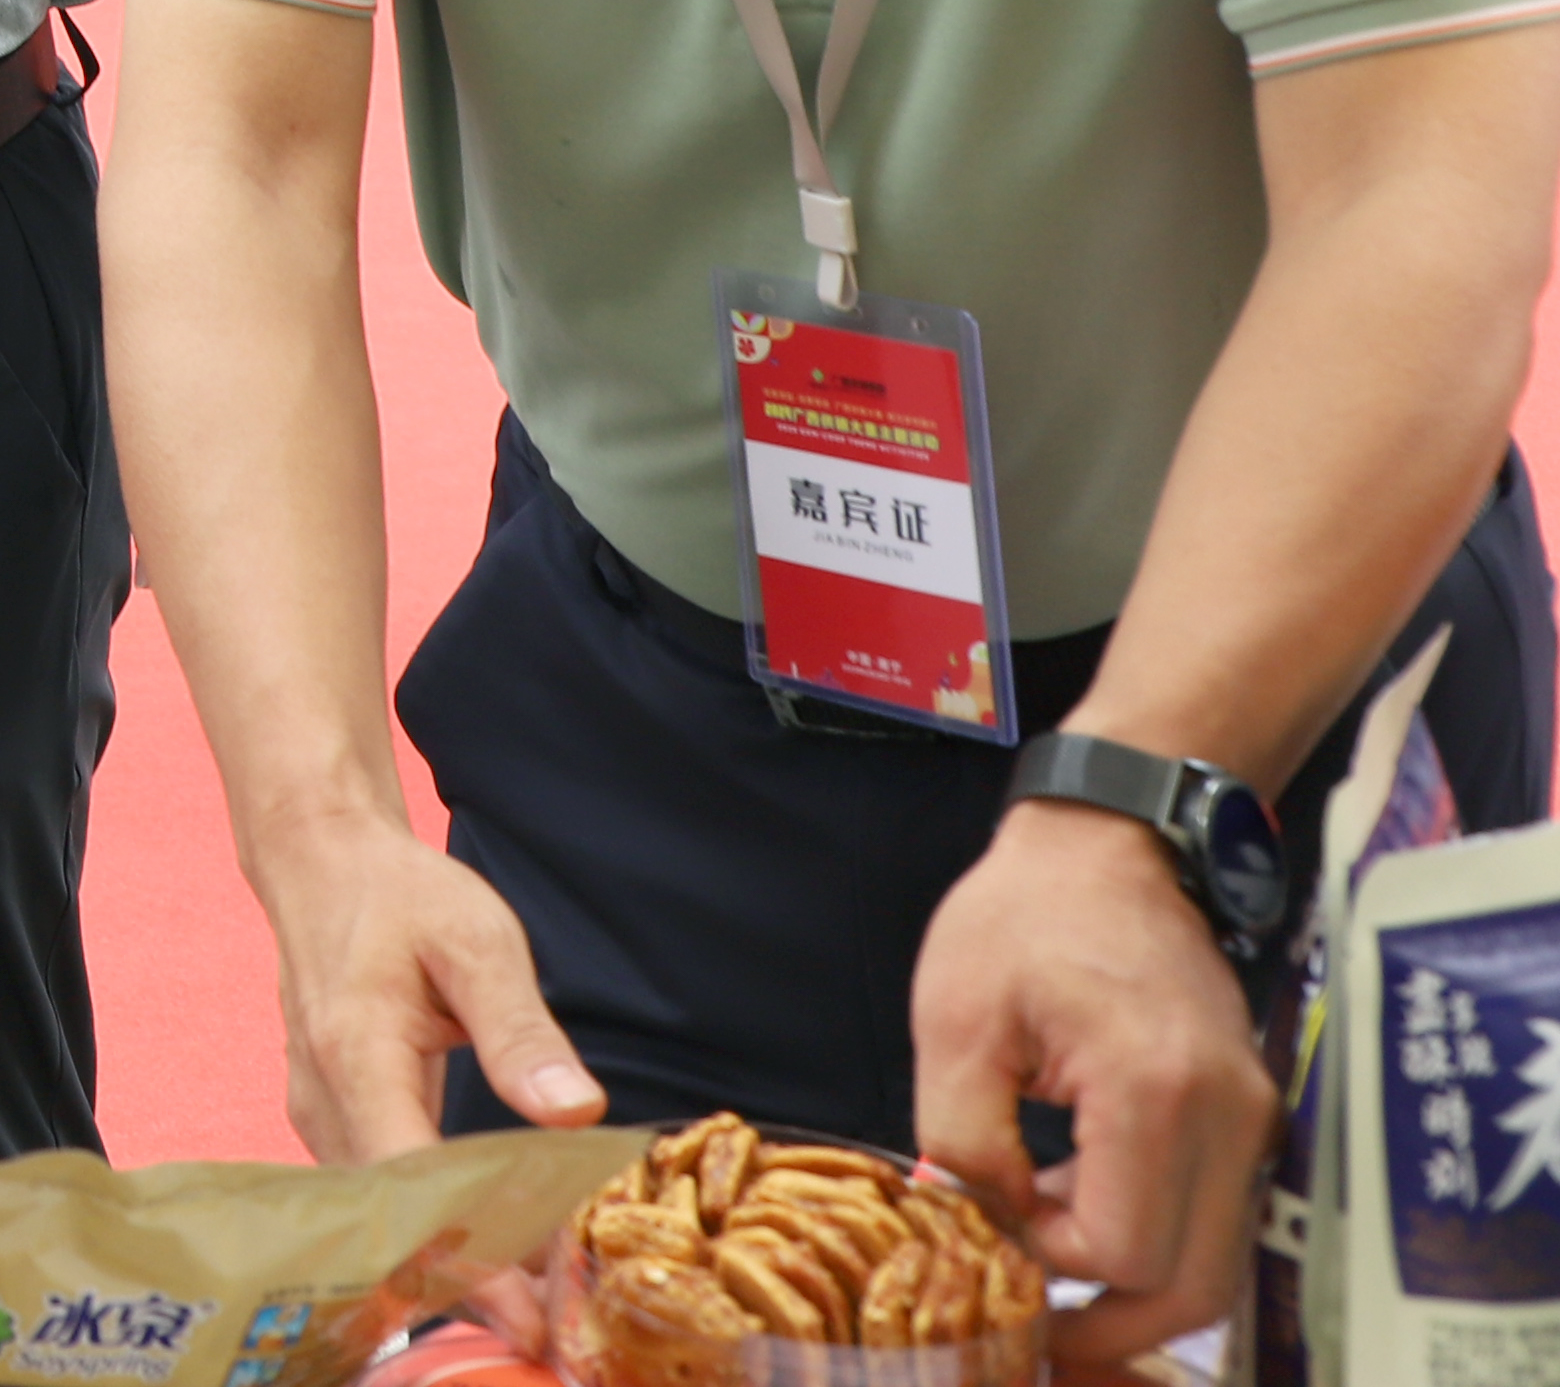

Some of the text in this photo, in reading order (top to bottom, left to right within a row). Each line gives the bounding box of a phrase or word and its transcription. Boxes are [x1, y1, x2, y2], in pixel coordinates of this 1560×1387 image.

[788, 476, 932, 546] 嘉宾证
[32, 1293, 192, 1349] 冰泉
